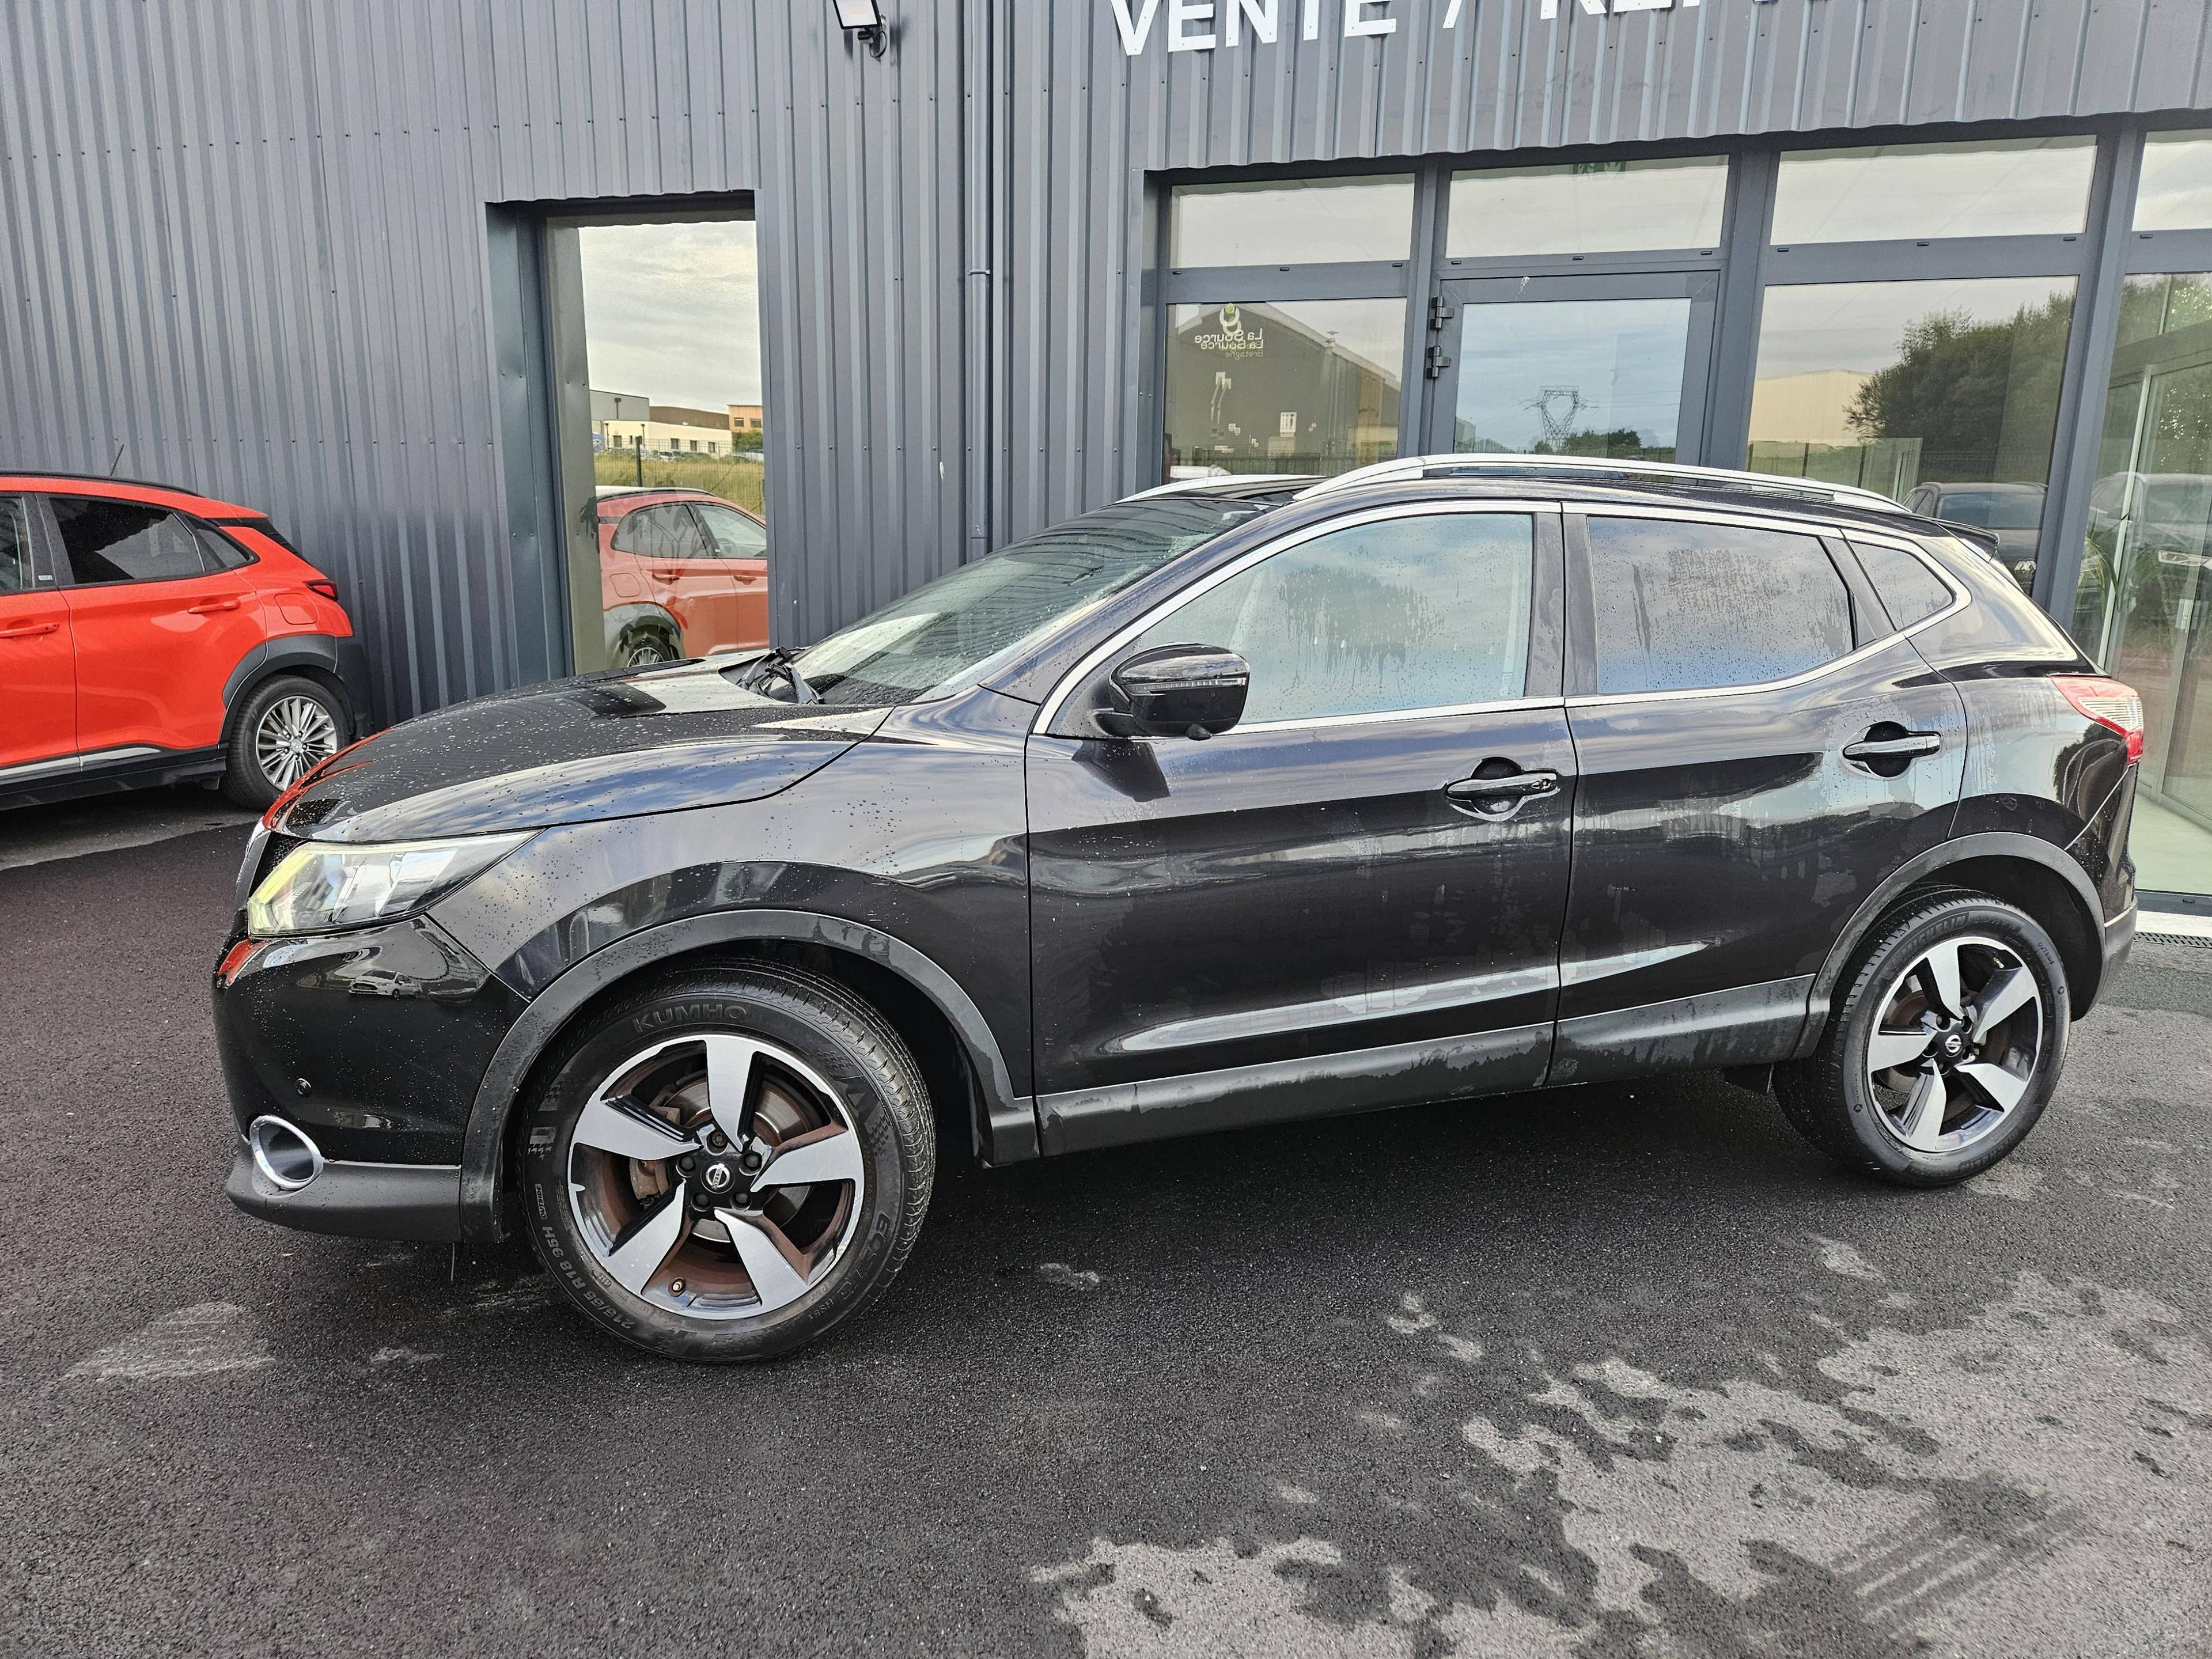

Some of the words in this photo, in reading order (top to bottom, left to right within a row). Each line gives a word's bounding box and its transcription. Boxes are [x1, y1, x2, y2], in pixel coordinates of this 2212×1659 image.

[632, 1003, 747, 1034] KUMHO
[535, 1184, 547, 1219] OUTSIDE
[542, 1226, 564, 1258] 95H
[559, 1260, 586, 1290] R18
[583, 1290, 635, 1329] 215/55
